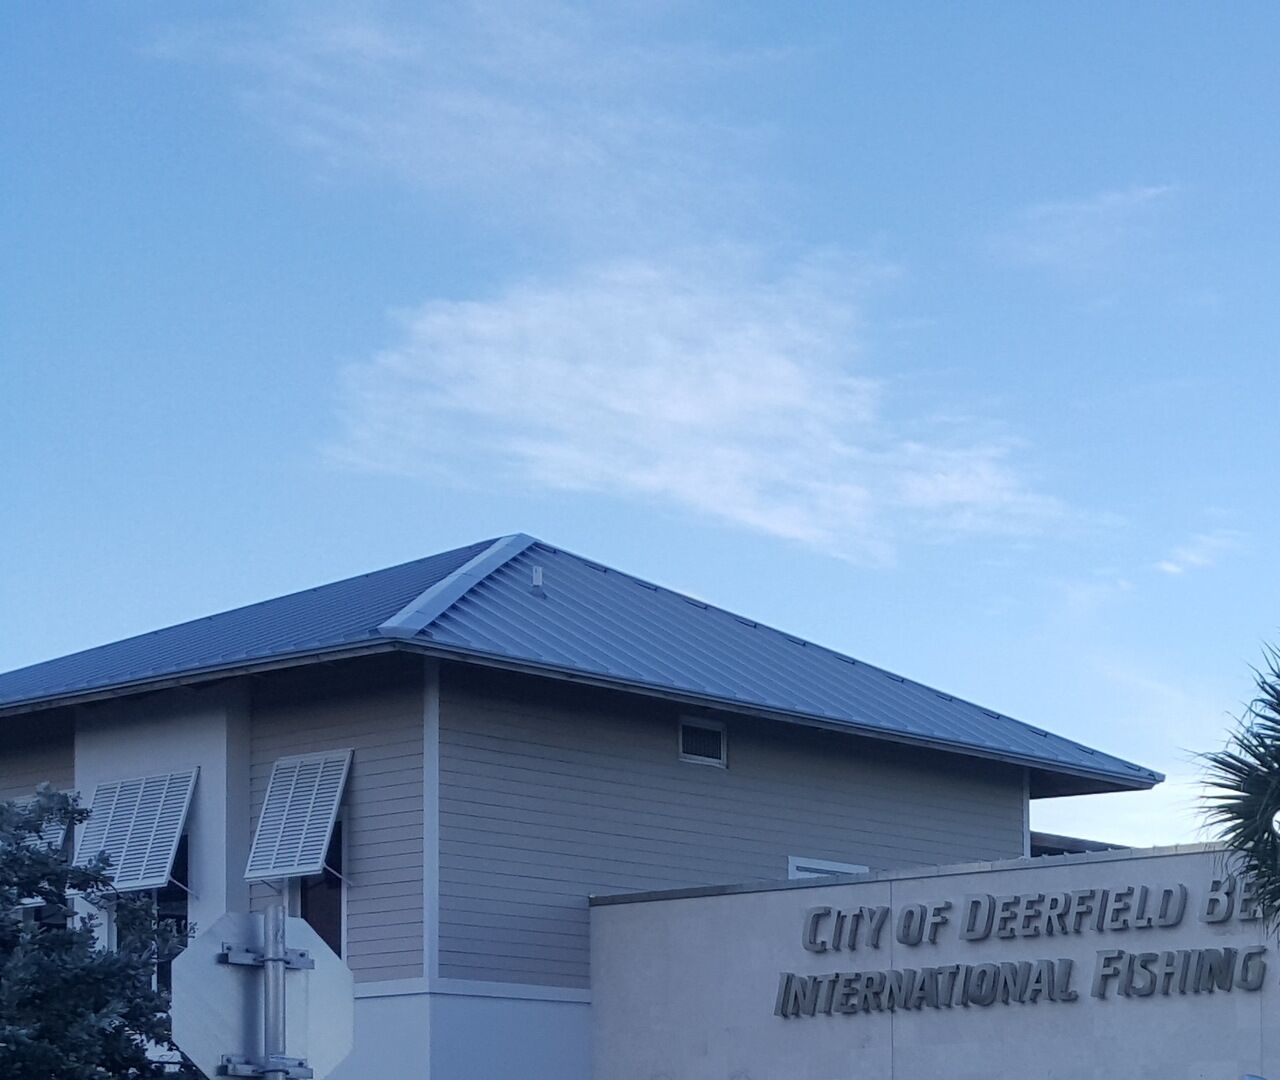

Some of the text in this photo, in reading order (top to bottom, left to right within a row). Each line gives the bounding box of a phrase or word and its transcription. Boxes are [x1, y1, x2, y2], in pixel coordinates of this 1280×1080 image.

[802, 905, 889, 953] CITY
[896, 901, 952, 946] OF
[959, 884, 1188, 941] DEERFIELD
[774, 957, 1080, 1019] INTERNATIONAL
[1090, 943, 1268, 999] FISHING
